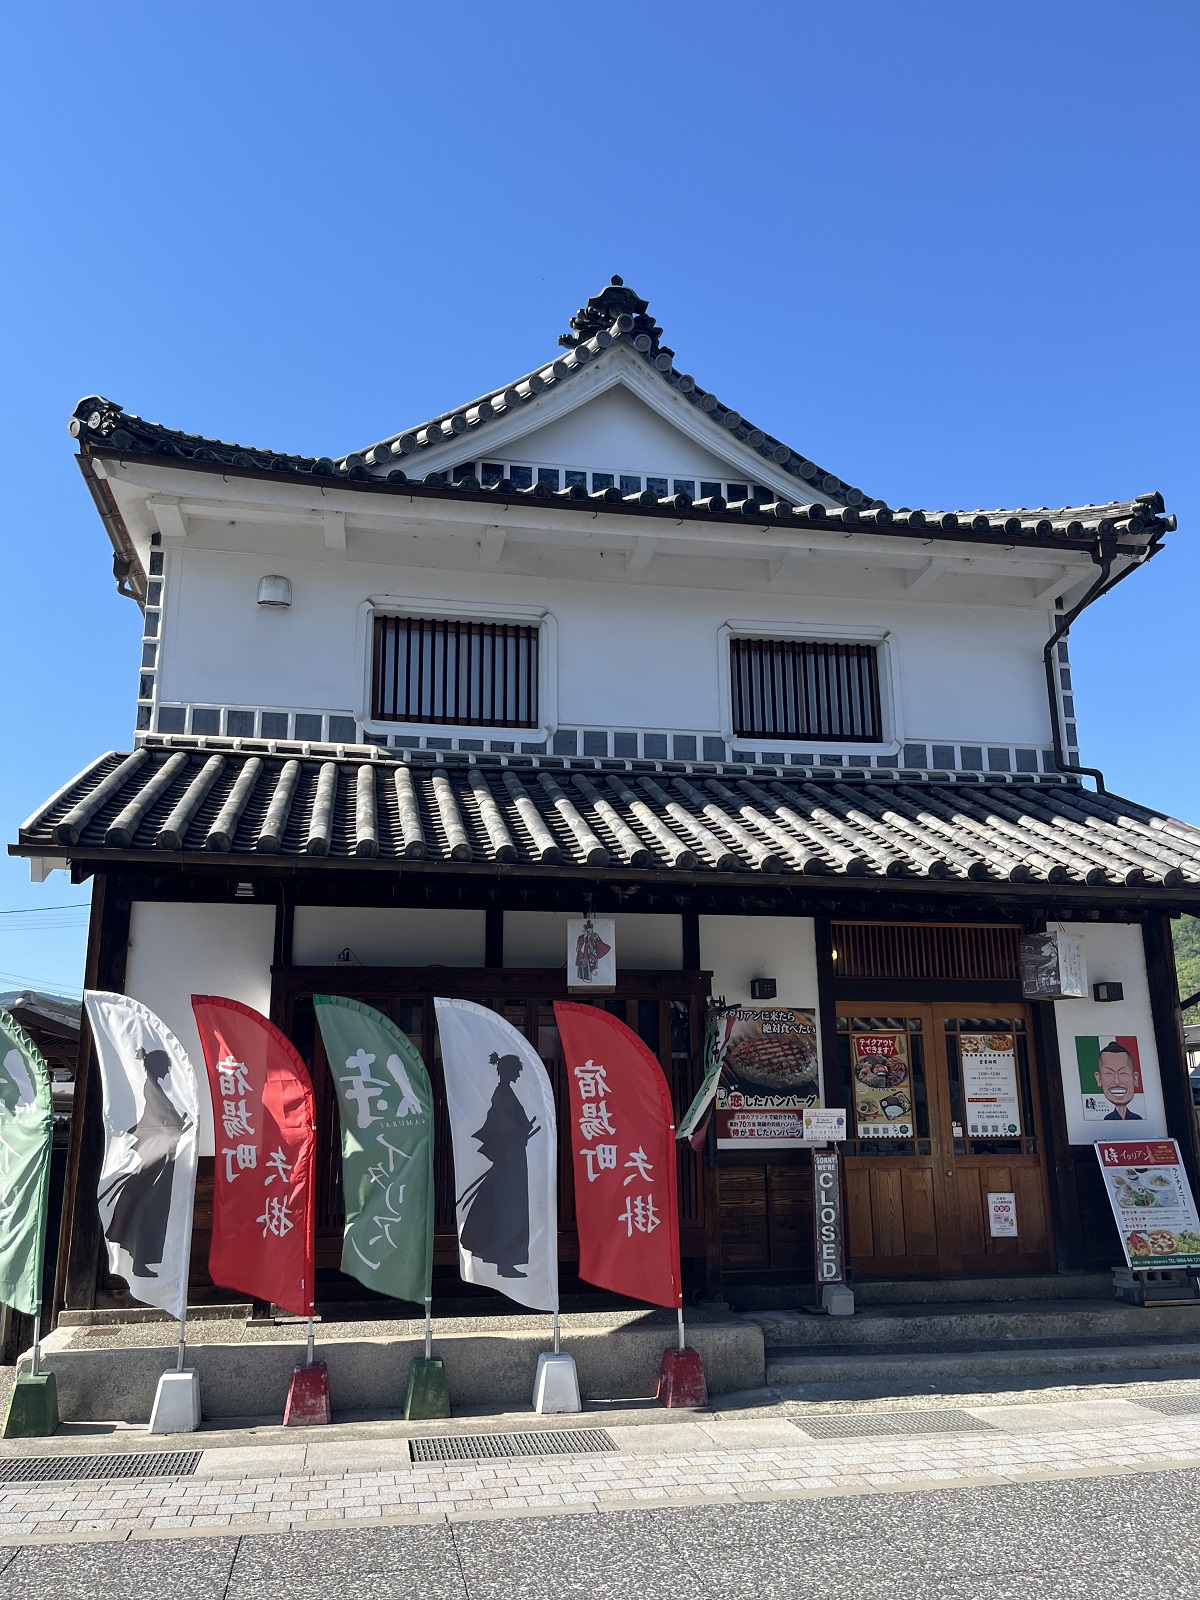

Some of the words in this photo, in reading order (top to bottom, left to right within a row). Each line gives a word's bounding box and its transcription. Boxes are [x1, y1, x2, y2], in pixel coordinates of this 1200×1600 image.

[762, 1023, 817, 1034] 絶対食べたい
[859, 1038, 894, 1047] テイクアウト
[865, 1047, 890, 1055] できます
[816, 1156, 836, 1164] SORRY
[1104, 1147, 1119, 1164] 侍
[1120, 1149, 1152, 1161] イタリアン
[1172, 1167, 1186, 1207] ランチメニュー
[819, 1172, 837, 1278] CLOSED
